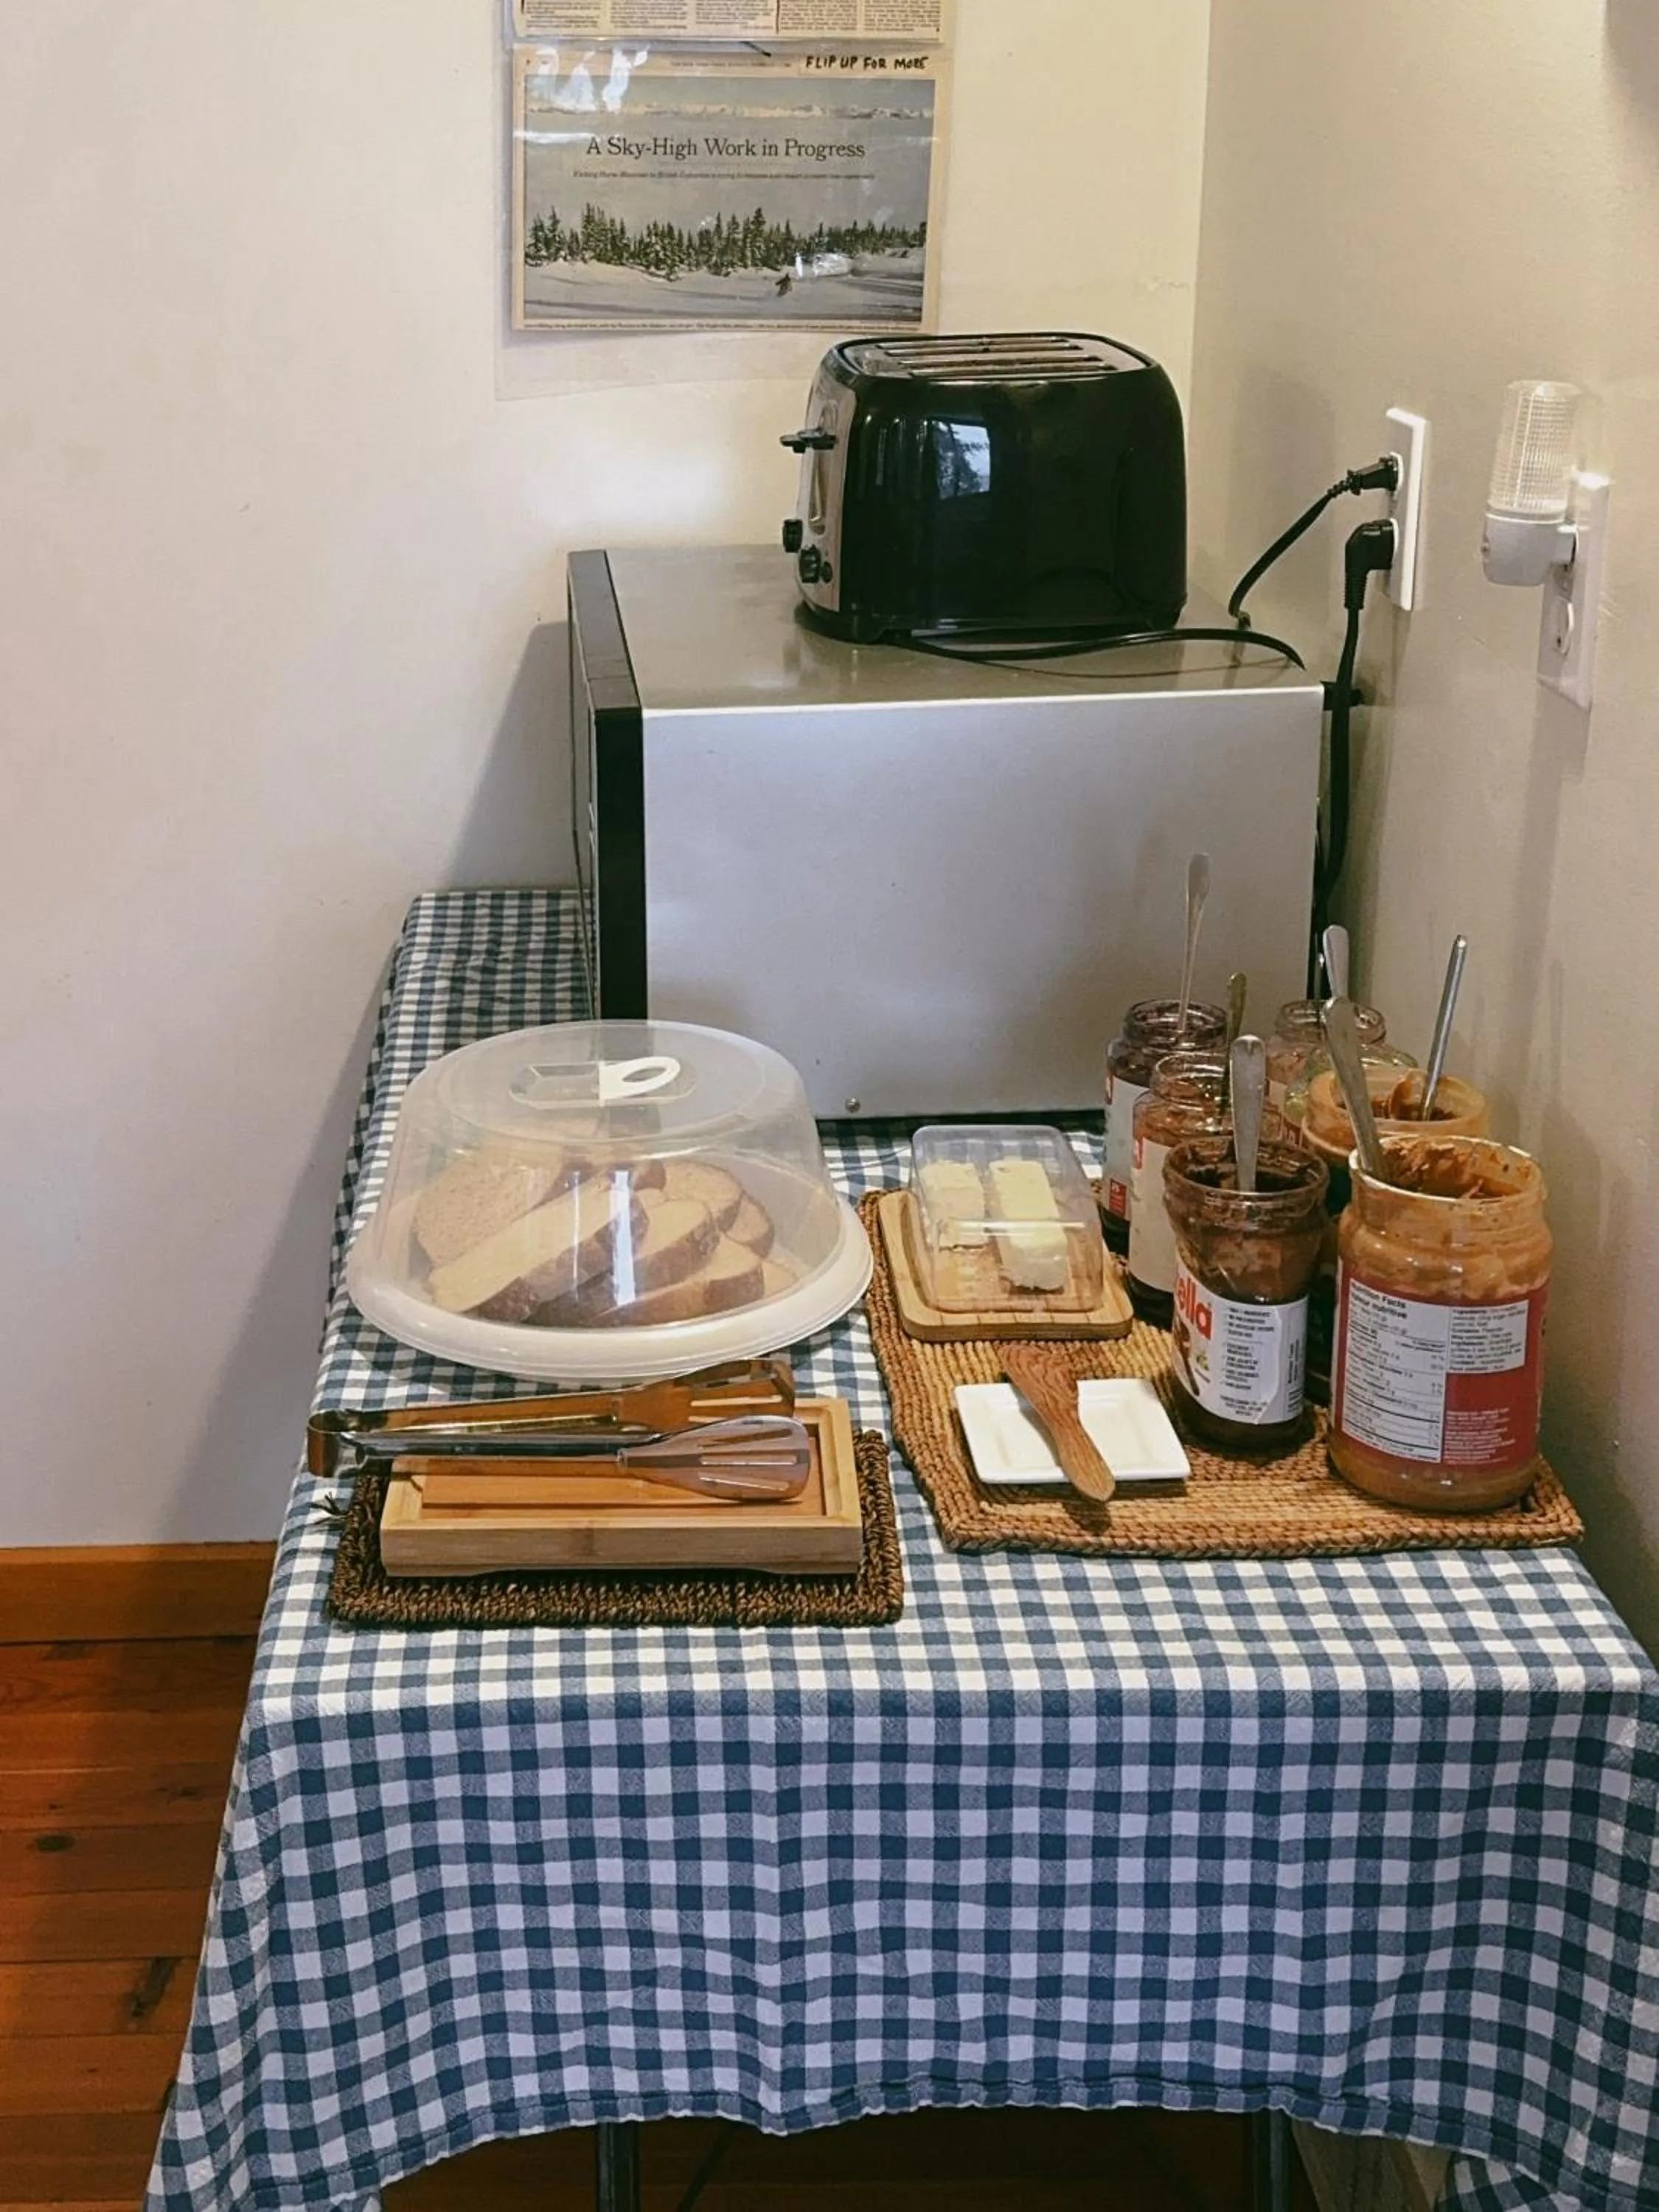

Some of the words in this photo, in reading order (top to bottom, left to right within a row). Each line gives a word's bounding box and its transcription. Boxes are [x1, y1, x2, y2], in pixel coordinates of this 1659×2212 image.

[805, 55, 837, 69] FLIP
[840, 55, 858, 69] UP
[863, 56, 887, 69] FOR
[894, 56, 929, 69] MORE
[586, 136, 602, 156] A
[607, 136, 698, 161] Sky-High
[703, 137, 757, 156] Work
[762, 138, 779, 156] in
[784, 137, 866, 161] Progress
